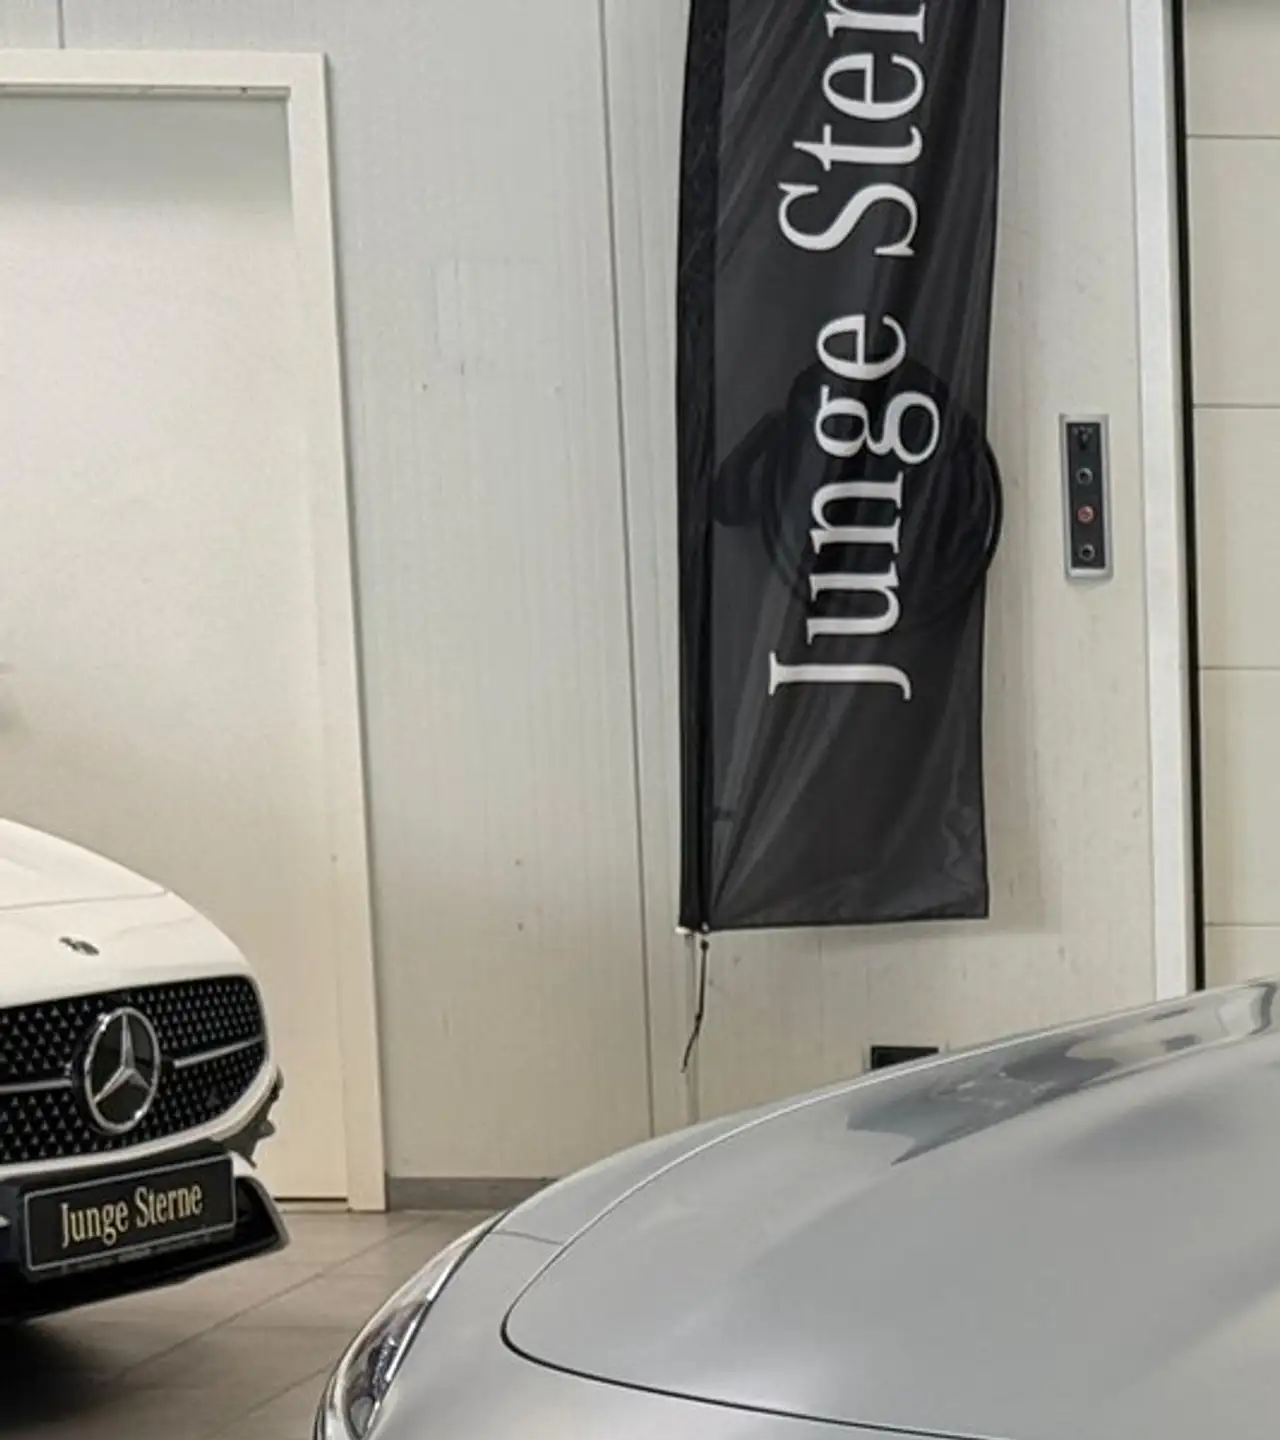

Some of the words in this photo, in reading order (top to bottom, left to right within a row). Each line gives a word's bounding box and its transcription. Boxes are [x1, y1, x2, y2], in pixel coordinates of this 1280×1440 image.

[768, 312, 940, 702] Junge
[60, 1202, 129, 1249] Junge
[134, 1184, 203, 1229] Sterne
